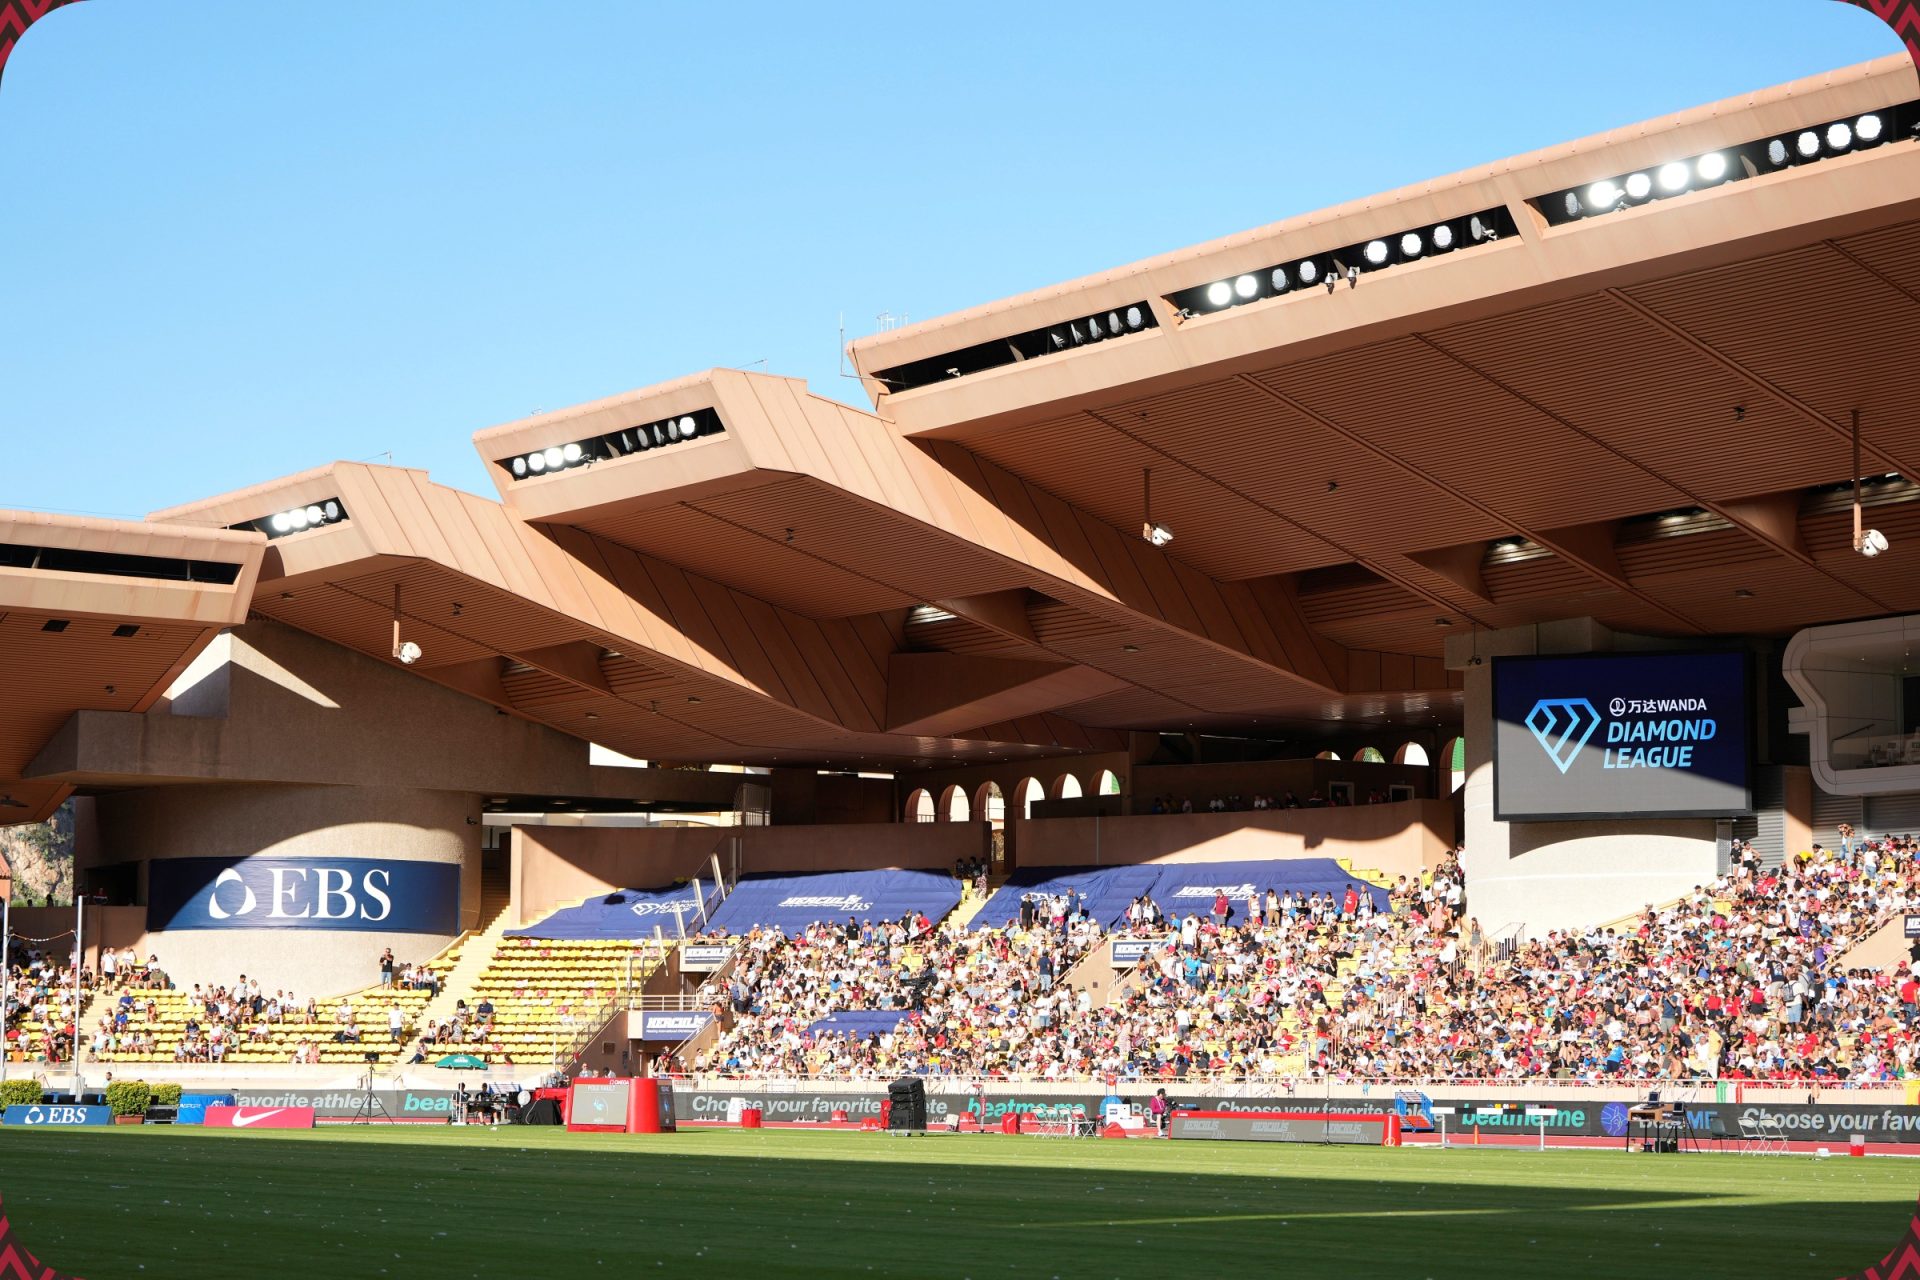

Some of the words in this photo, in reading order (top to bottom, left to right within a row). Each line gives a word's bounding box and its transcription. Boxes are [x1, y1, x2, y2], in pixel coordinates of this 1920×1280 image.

[1656, 698, 1707, 712] WANDA
[1607, 719, 1717, 743] DIAMOND
[1603, 745, 1694, 769] LEAGUE
[267, 867, 391, 921] EBS
[839, 902, 873, 911] EBS
[47, 1107, 87, 1124] EBS
[692, 1096, 763, 1112] Chose
[766, 1101, 809, 1116] your
[812, 1097, 882, 1114] favorite
[1742, 1108, 1824, 1129] Choose
[1828, 1114, 1879, 1134] your
